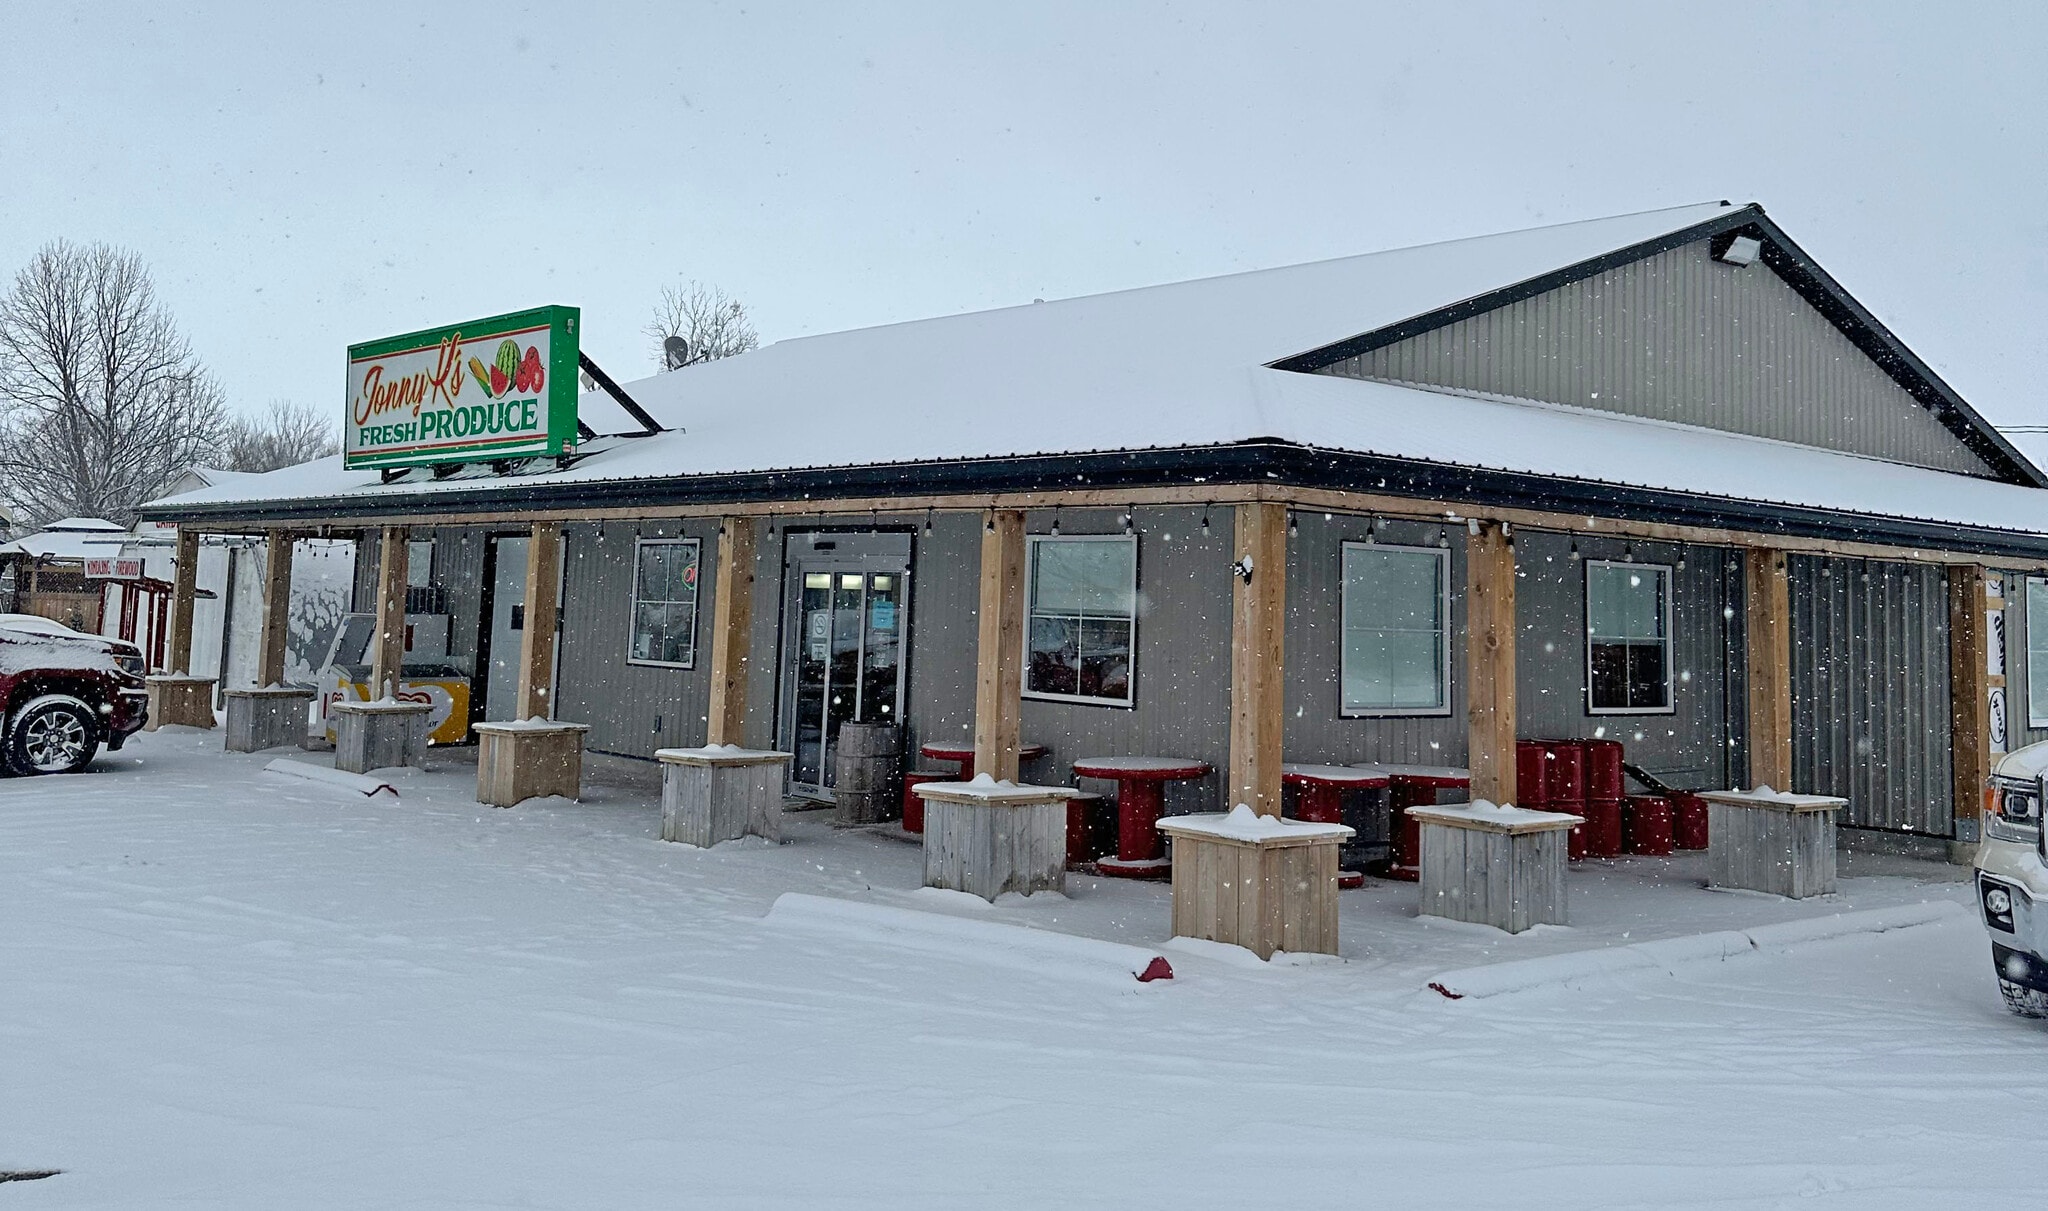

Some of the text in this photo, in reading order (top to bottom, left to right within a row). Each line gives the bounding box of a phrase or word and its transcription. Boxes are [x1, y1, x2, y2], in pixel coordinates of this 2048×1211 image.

[355, 366, 427, 425] Jonny
[359, 398, 539, 447] FRESH PRODUCE
